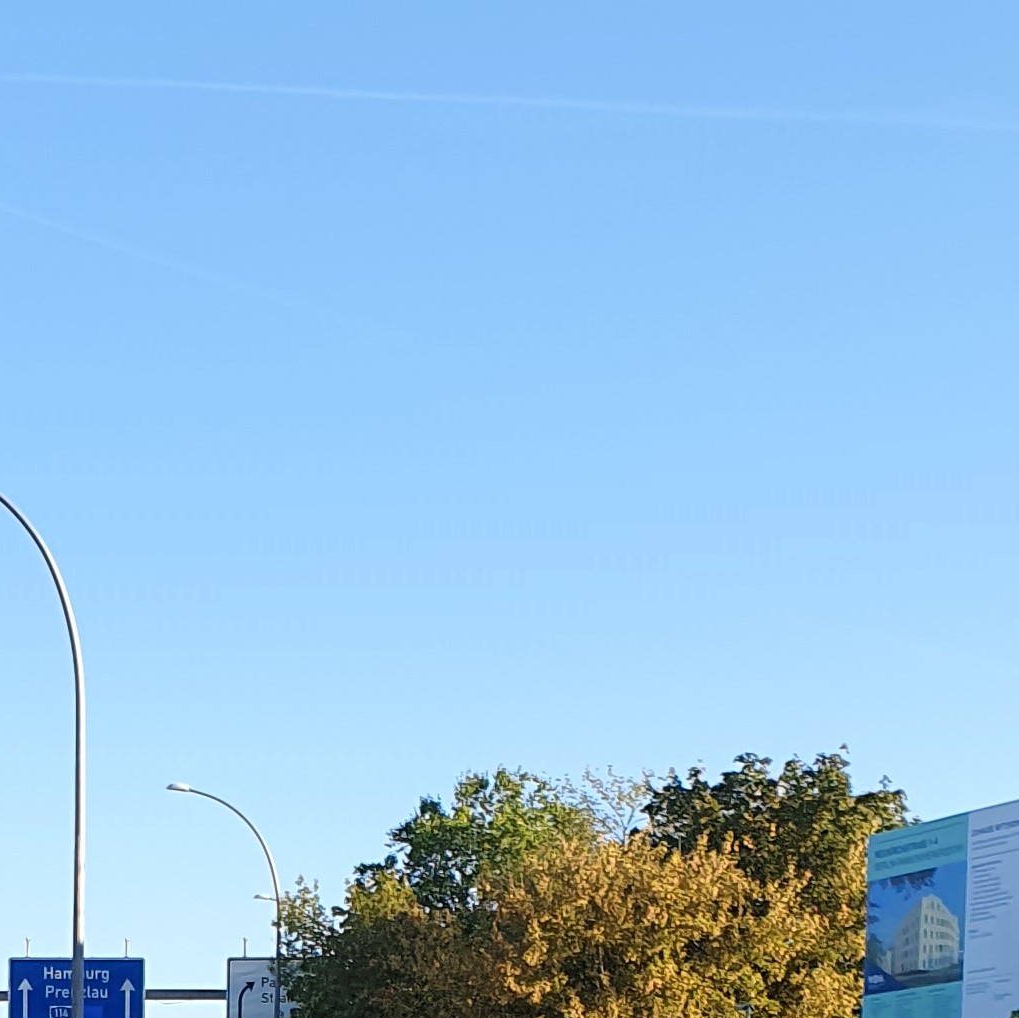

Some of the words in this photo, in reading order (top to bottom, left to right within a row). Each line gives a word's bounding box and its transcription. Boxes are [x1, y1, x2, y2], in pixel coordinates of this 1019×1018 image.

[43, 966, 110, 984] Hamurg
[44, 985, 109, 999] Prezlau
[53, 1008, 69, 1018] 114
